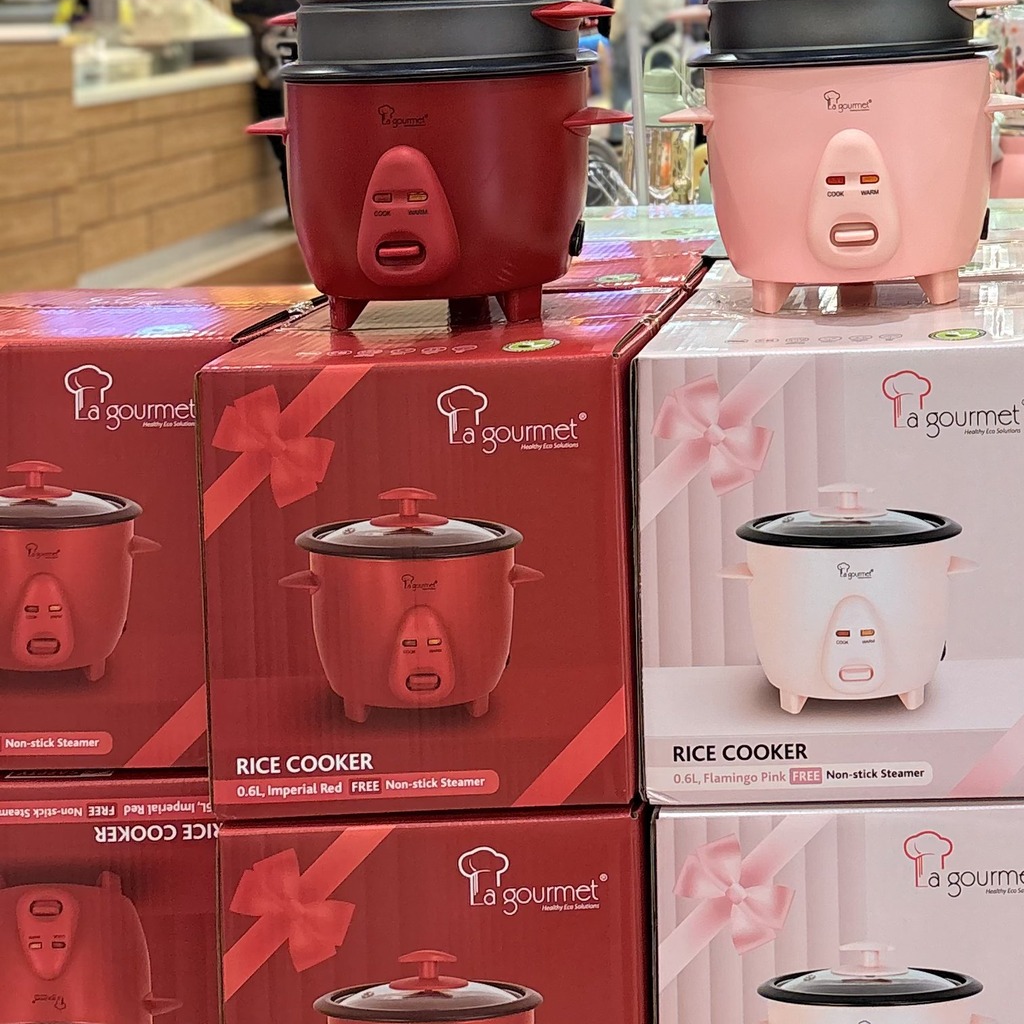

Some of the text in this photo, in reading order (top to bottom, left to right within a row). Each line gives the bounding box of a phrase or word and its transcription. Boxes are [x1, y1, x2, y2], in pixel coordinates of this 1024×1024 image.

[105, 399, 195, 431] gourmet
[926, 404, 1020, 438] gourmet
[482, 418, 578, 454] gourmet
[964, 428, 985, 436] Healthy
[4, 736, 100, 748] Non-stick Steamer
[673, 743, 808, 762] RICE COOKER
[236, 753, 374, 775] RICE COOKER
[673, 767, 925, 786] 0.6L, Flamingo Pink FREE Non-stick Steamer
[237, 776, 486, 799] 0.6L, Imperial Red FREE Non-stick Steamer
[33, 802, 195, 818] Imperial Red FREE Non-stick
[94, 824, 178, 843] COOKER
[503, 879, 598, 916] gourmet
